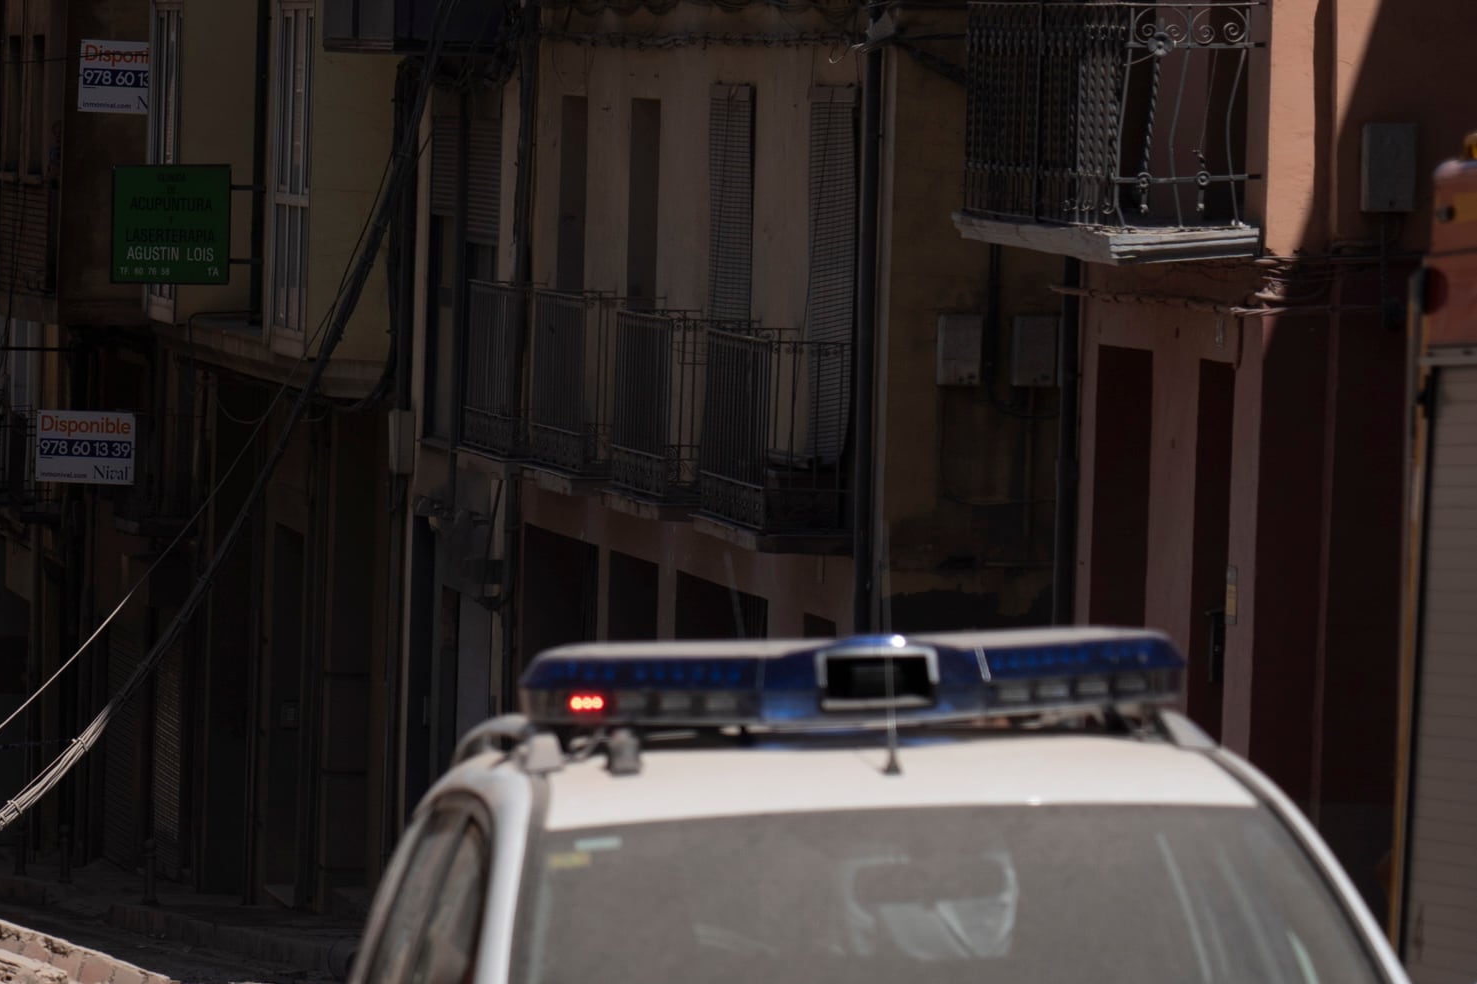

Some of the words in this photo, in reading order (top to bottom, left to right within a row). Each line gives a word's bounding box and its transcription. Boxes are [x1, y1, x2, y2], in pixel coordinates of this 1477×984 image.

[83, 71, 112, 85] 978
[116, 72, 134, 86] 60
[130, 196, 212, 212] ACUPUNTURA
[125, 228, 215, 243] LASERTERAPIA
[126, 246, 179, 261] AGUSTIN
[187, 247, 215, 262] LOIS
[40, 415, 131, 437] Disponible
[40, 440, 68, 455] 978
[71, 441, 90, 455] 60
[93, 442, 109, 456] 13
[111, 443, 130, 457] 39
[92, 465, 128, 480] Nival
